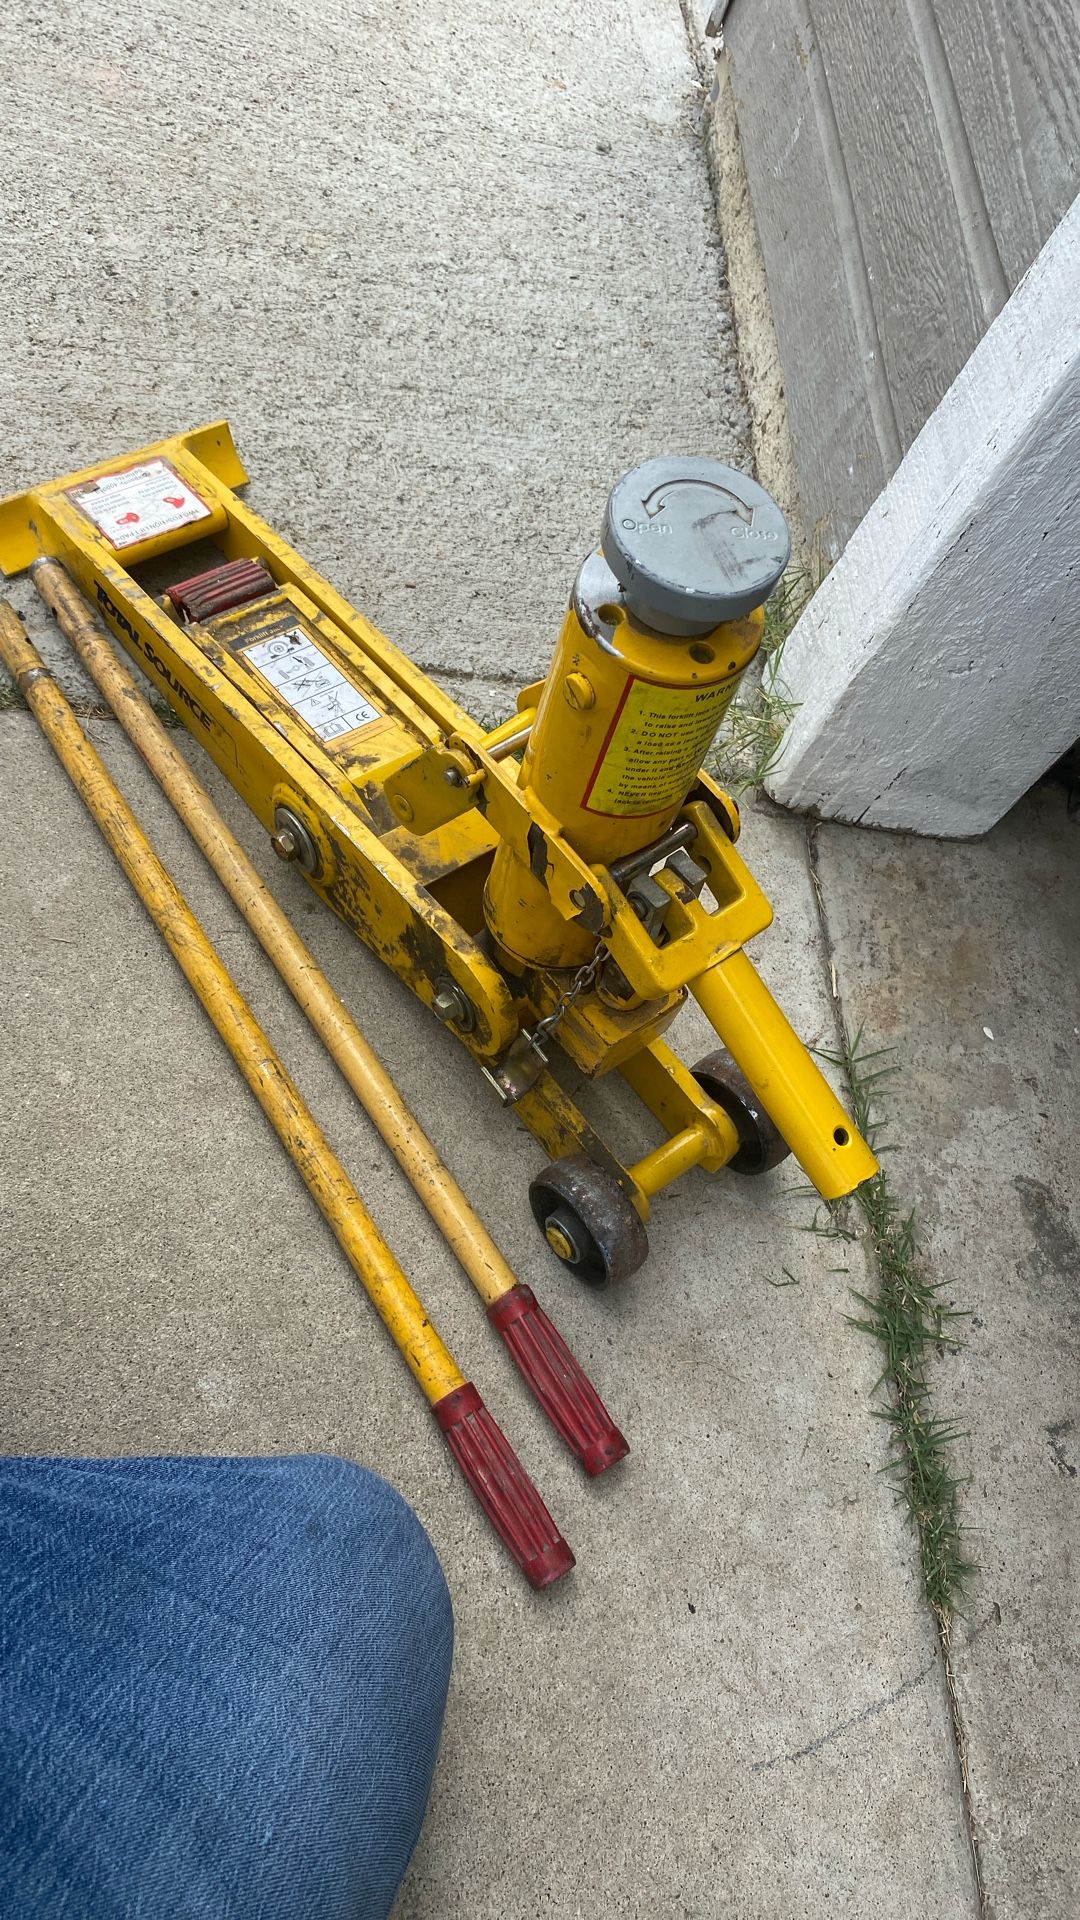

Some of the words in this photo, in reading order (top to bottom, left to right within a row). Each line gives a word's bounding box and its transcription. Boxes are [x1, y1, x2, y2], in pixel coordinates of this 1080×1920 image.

[621, 518, 673, 535] Open
[730, 526, 778, 541] Close
[244, 630, 269, 645] Forklift
[93, 579, 142, 650] TOTAL
[143, 642, 213, 733] SOURCE
[649, 712, 666, 720] This
[668, 712, 695, 720] forklift
[644, 740, 663, 748] load
[633, 748, 653, 756] After
[655, 748, 682, 757] raising
[628, 757, 650, 765] allow
[625, 766, 649, 774] under
[621, 773, 635, 781] the
[637, 774, 665, 782] vehicle
